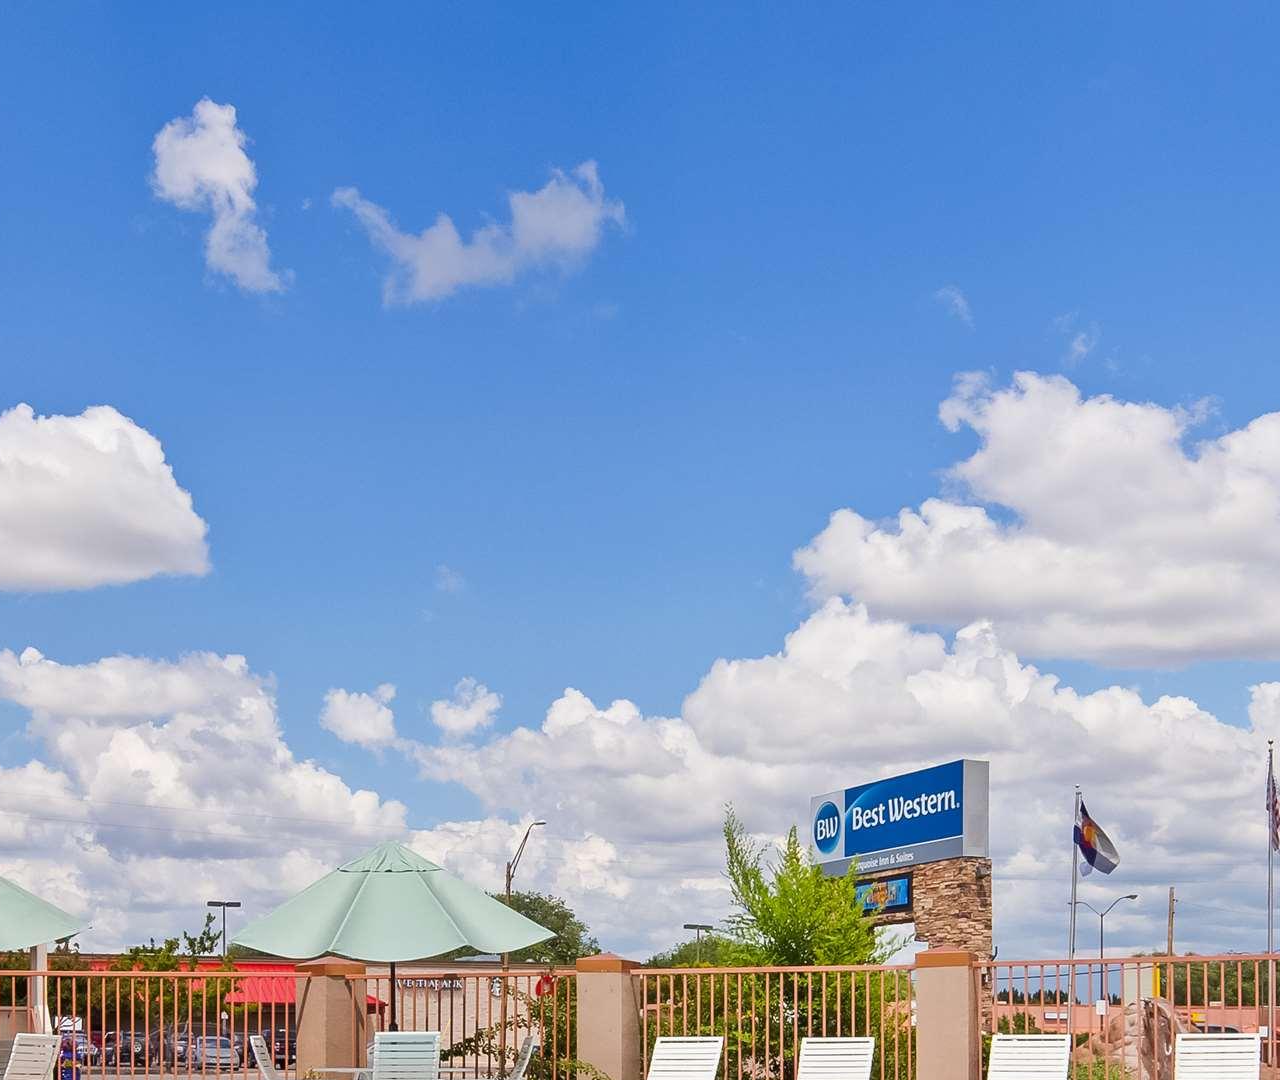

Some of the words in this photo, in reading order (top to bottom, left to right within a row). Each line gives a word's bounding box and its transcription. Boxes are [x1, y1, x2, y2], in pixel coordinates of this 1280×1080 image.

[816, 815, 838, 841] BW
[852, 803, 886, 831] Best
[879, 856, 889, 865] Inn
[896, 851, 914, 863] Suites
